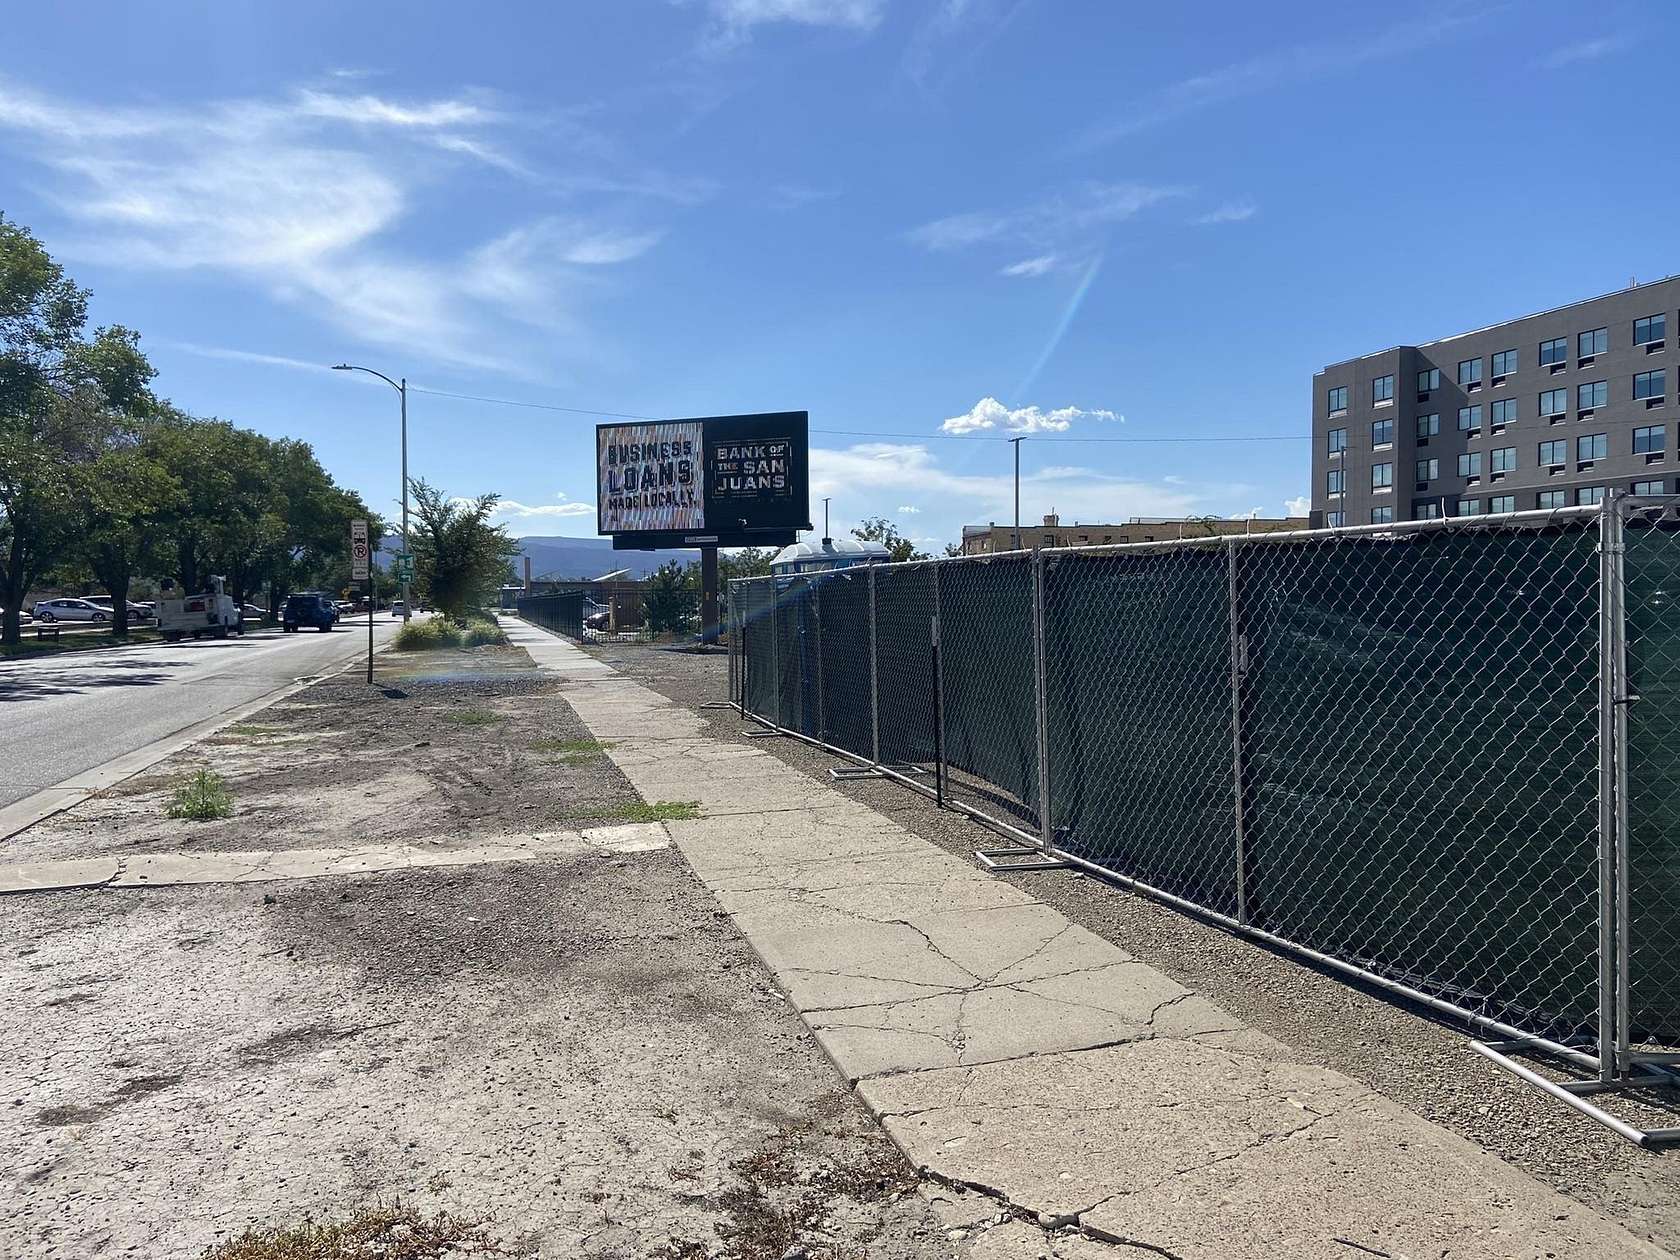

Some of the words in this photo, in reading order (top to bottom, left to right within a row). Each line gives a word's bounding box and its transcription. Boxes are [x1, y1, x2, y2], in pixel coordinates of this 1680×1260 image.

[608, 441, 692, 465] BUSINESS
[717, 446, 767, 460] BANK
[769, 445, 785, 454] OF
[743, 459, 785, 474] SAN
[608, 460, 693, 495] LOANS
[717, 475, 785, 490] JUANS
[608, 496, 640, 510] MADE
